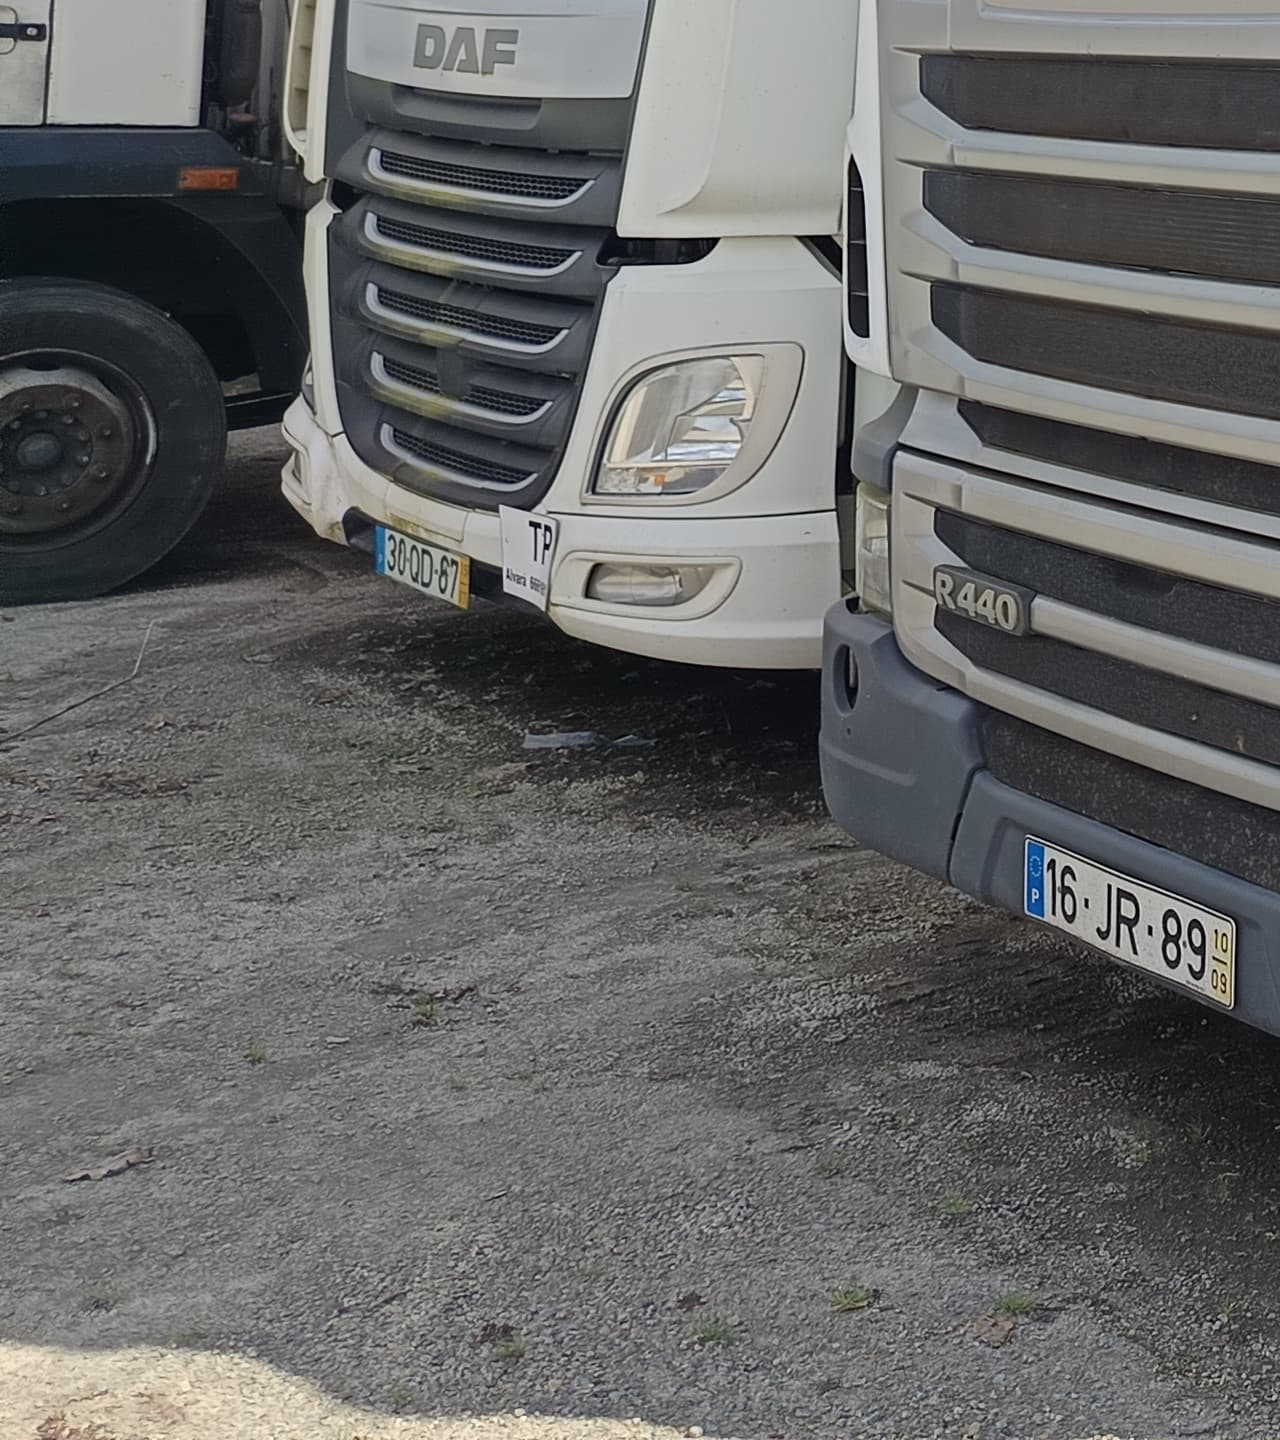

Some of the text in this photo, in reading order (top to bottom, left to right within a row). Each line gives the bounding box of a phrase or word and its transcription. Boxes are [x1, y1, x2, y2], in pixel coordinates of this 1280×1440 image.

[413, 23, 519, 76] DAF
[529, 520, 552, 565] TP
[956, 582, 1018, 631] 440
[1031, 888, 1039, 903] P
[1214, 928, 1229, 954] 10
[1210, 968, 1227, 995] 09
